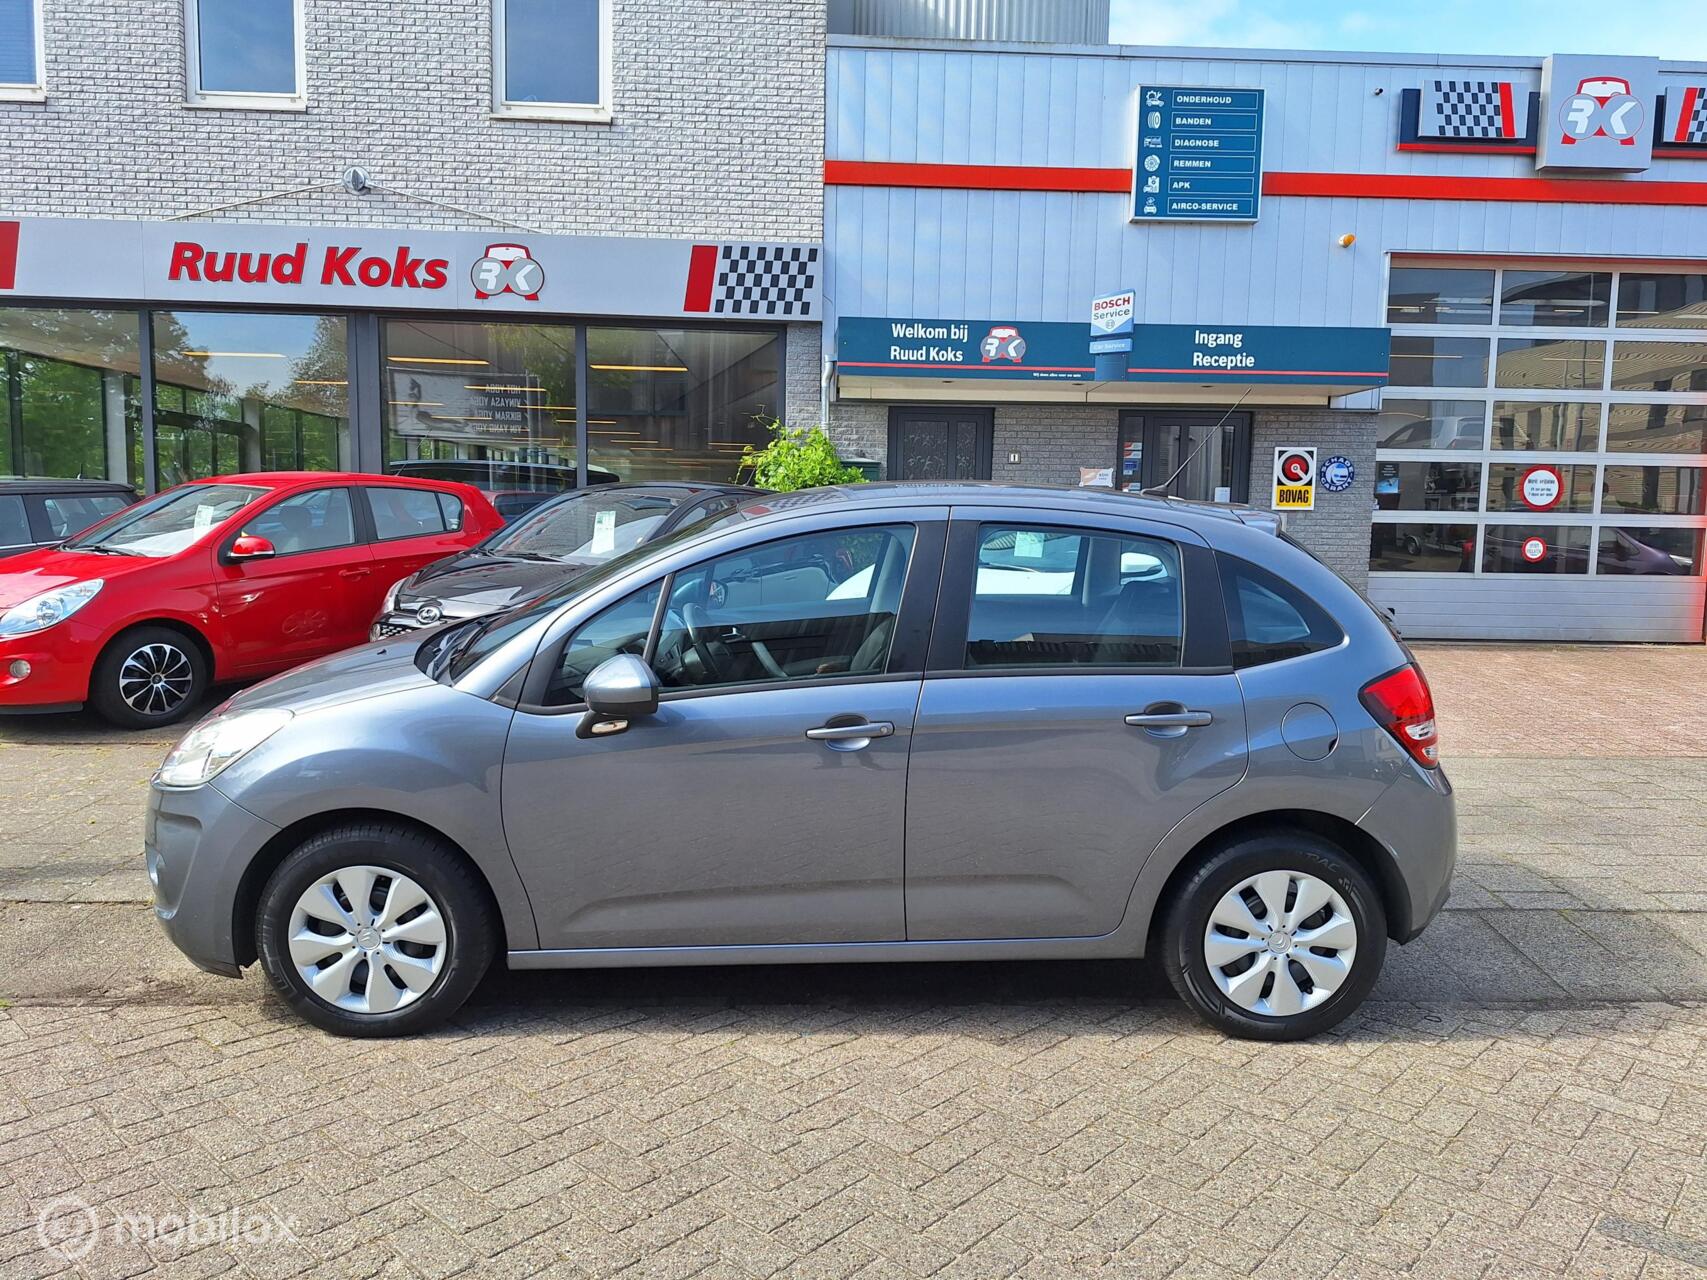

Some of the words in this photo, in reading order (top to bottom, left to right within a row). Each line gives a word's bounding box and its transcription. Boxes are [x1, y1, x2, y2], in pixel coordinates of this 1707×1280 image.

[1176, 95, 1232, 104] ONDERHOUD
[1175, 117, 1212, 126] BANDEN
[1174, 139, 1220, 148] DIAGNOSE
[1173, 160, 1212, 168] REMMEN
[1172, 181, 1191, 189] APK
[1171, 202, 1239, 211] AIRCO-SERVICE
[168, 241, 309, 284] Ruud
[321, 246, 449, 289] Koks
[1093, 296, 1131, 312] BOSCH
[1093, 307, 1131, 321] Service
[891, 323, 948, 340] Welkom
[950, 324, 969, 342] bij
[1194, 330, 1243, 348] Ingang
[890, 346, 927, 361] Ruud
[929, 346, 964, 362] Koks
[1193, 352, 1255, 370] Receptie
[1321, 456, 1354, 472] SCHADE
[1279, 489, 1310, 503] BOVAG
